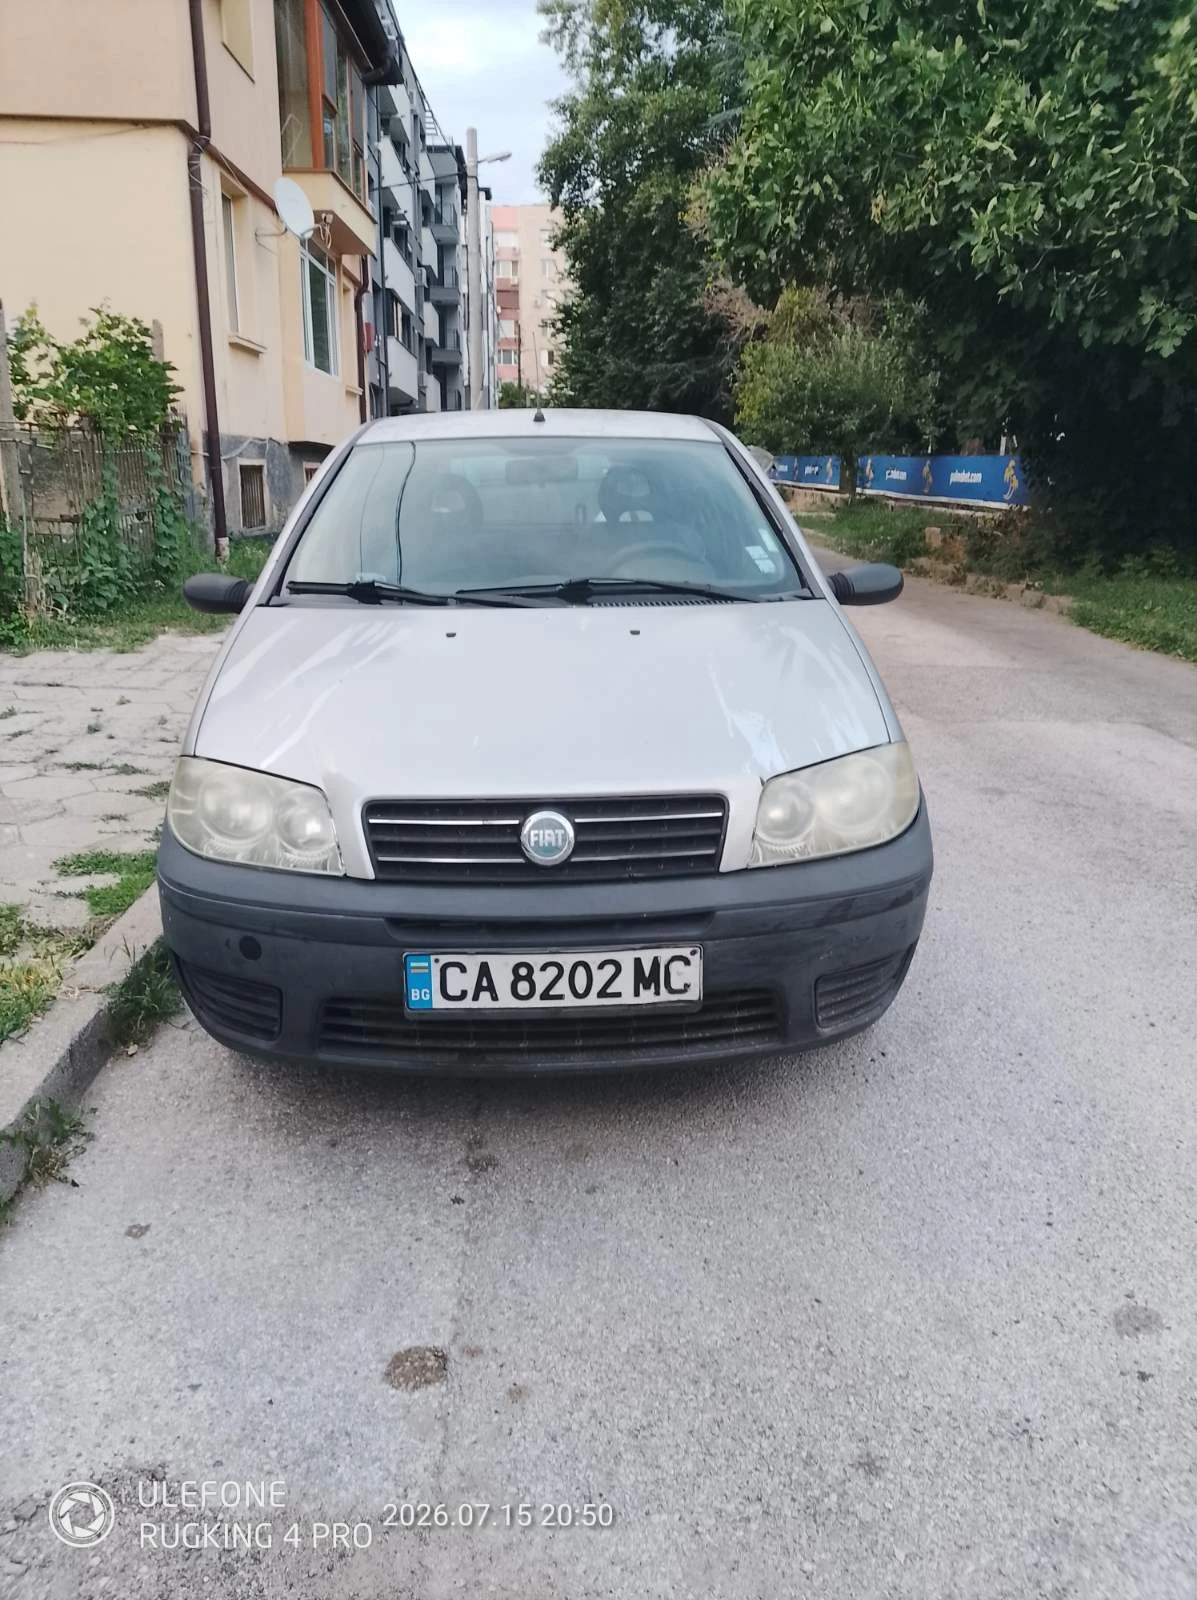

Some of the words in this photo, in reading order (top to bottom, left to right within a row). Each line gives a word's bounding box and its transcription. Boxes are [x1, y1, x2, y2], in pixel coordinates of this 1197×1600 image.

[529, 829, 565, 848] FIAT
[439, 961, 499, 1002] CA
[510, 959, 623, 1001] 8202
[633, 955, 692, 998] MC
[411, 988, 430, 1001] BG
